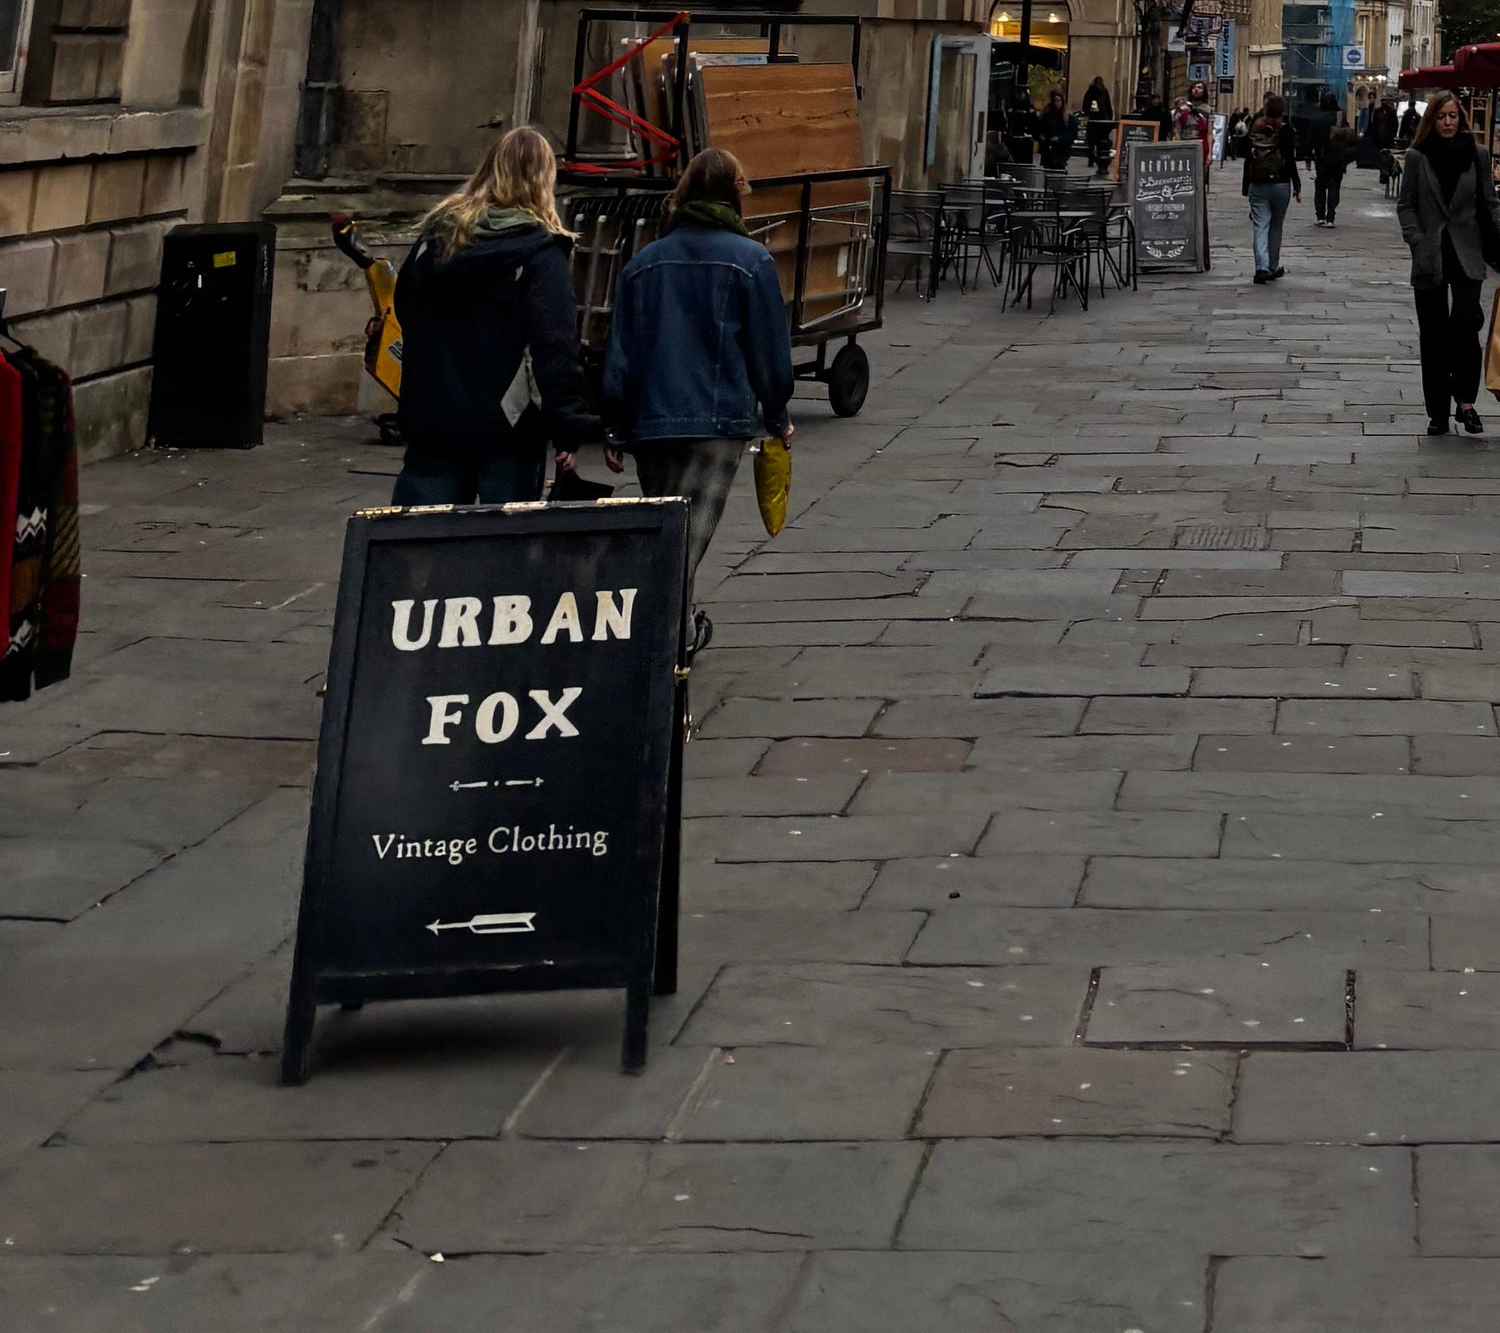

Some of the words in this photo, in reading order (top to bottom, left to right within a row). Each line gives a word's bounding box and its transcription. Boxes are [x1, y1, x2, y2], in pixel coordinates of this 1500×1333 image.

[390, 588, 638, 651] URBAN
[420, 686, 583, 746] FOX
[372, 833, 478, 865] Vintage
[488, 823, 609, 857] Clothing
